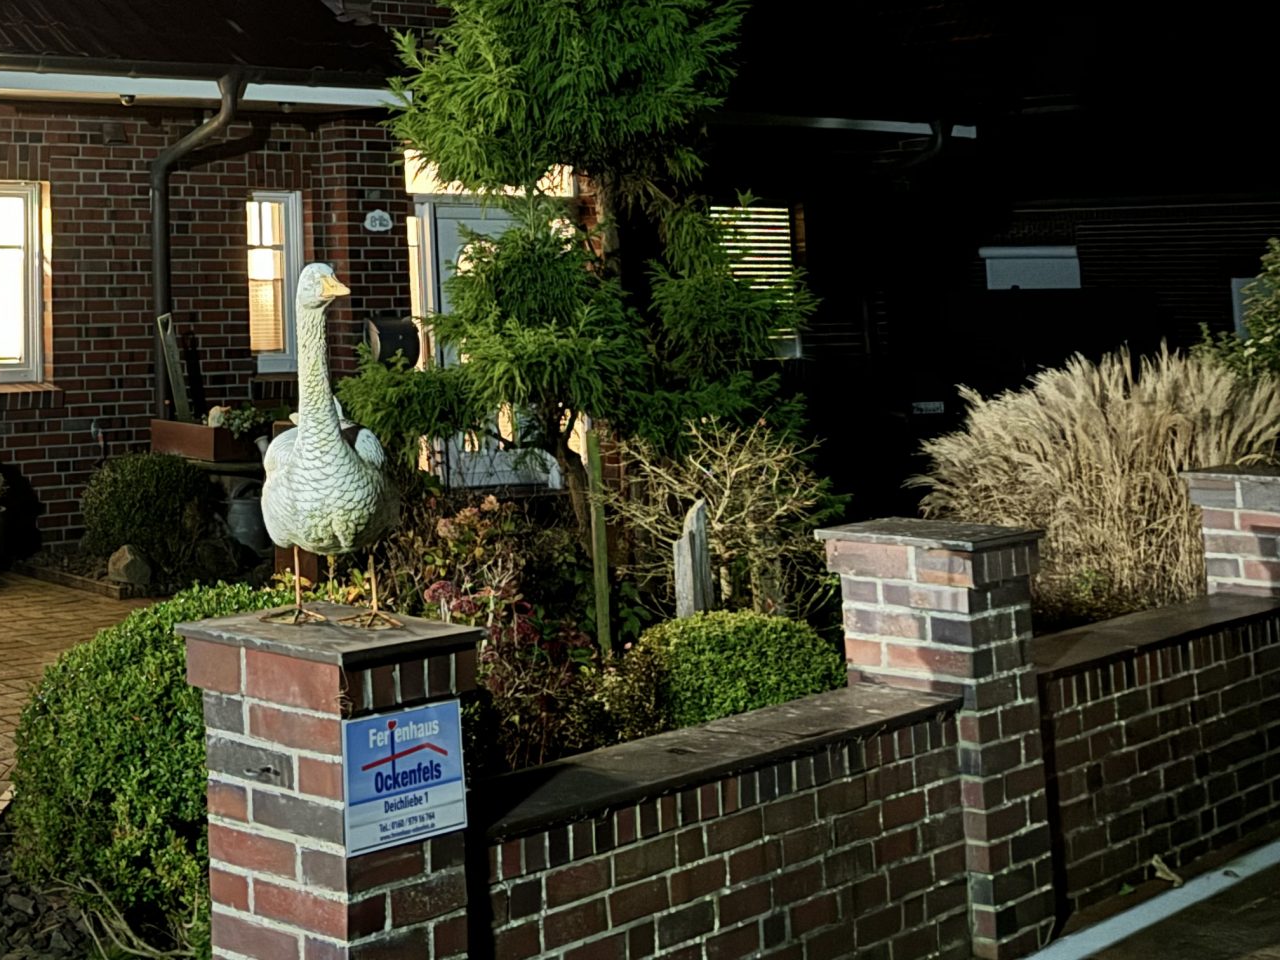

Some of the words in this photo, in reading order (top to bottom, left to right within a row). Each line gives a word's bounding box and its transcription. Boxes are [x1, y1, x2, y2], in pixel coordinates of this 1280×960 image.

[375, 760, 442, 793] Ockenfels
[384, 794, 423, 813] Deichliebe
[424, 792, 429, 803] 1
